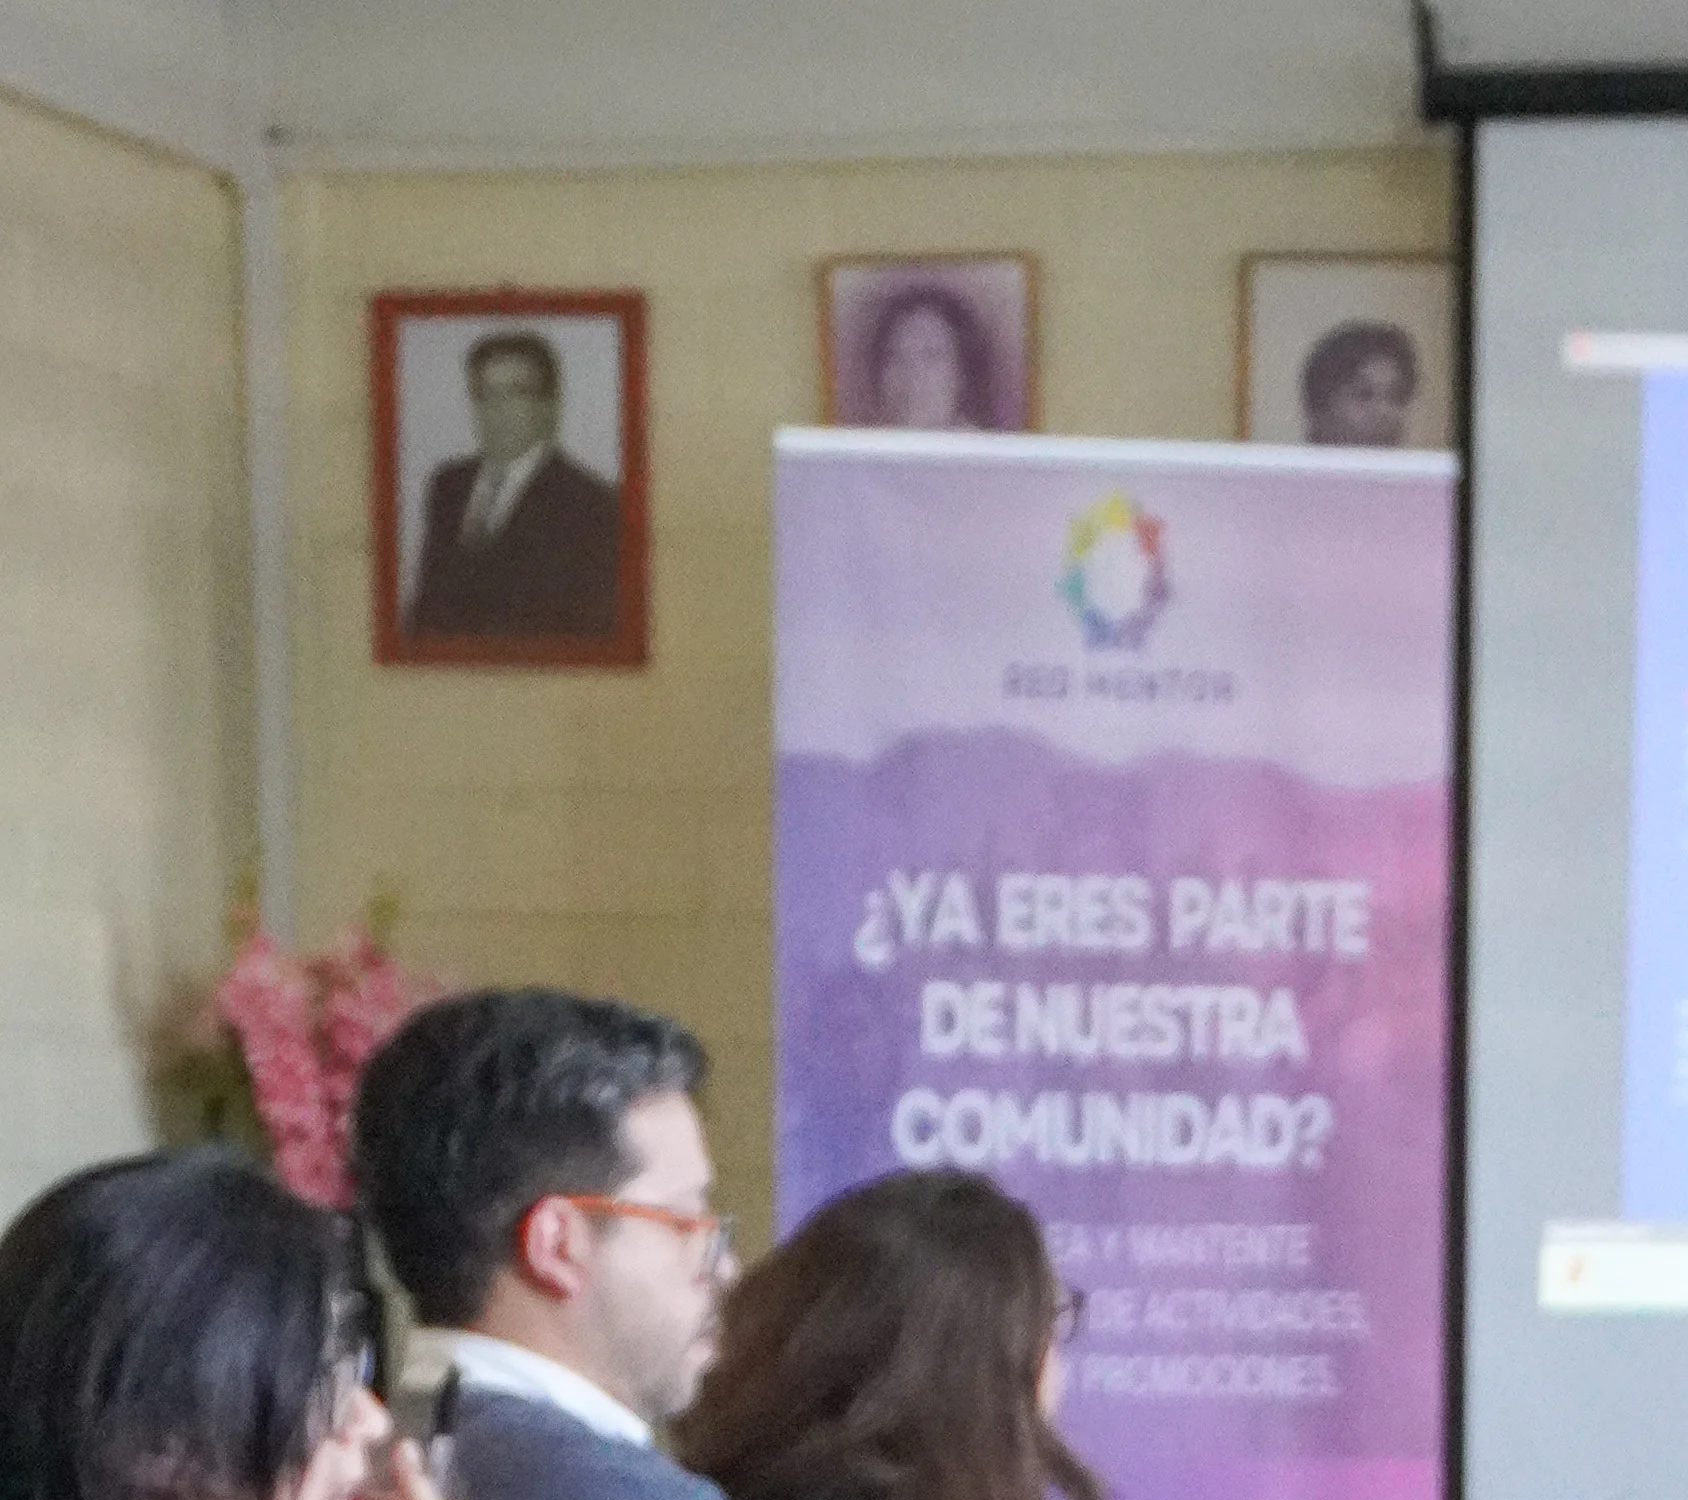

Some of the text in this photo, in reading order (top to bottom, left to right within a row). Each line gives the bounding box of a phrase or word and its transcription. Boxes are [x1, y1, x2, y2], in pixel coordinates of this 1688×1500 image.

[853, 868, 1372, 968] ¿YA ERES PARTE
[920, 981, 1309, 1062] DE NUESTRA
[892, 1088, 1332, 1168] COMUNIDAD?
